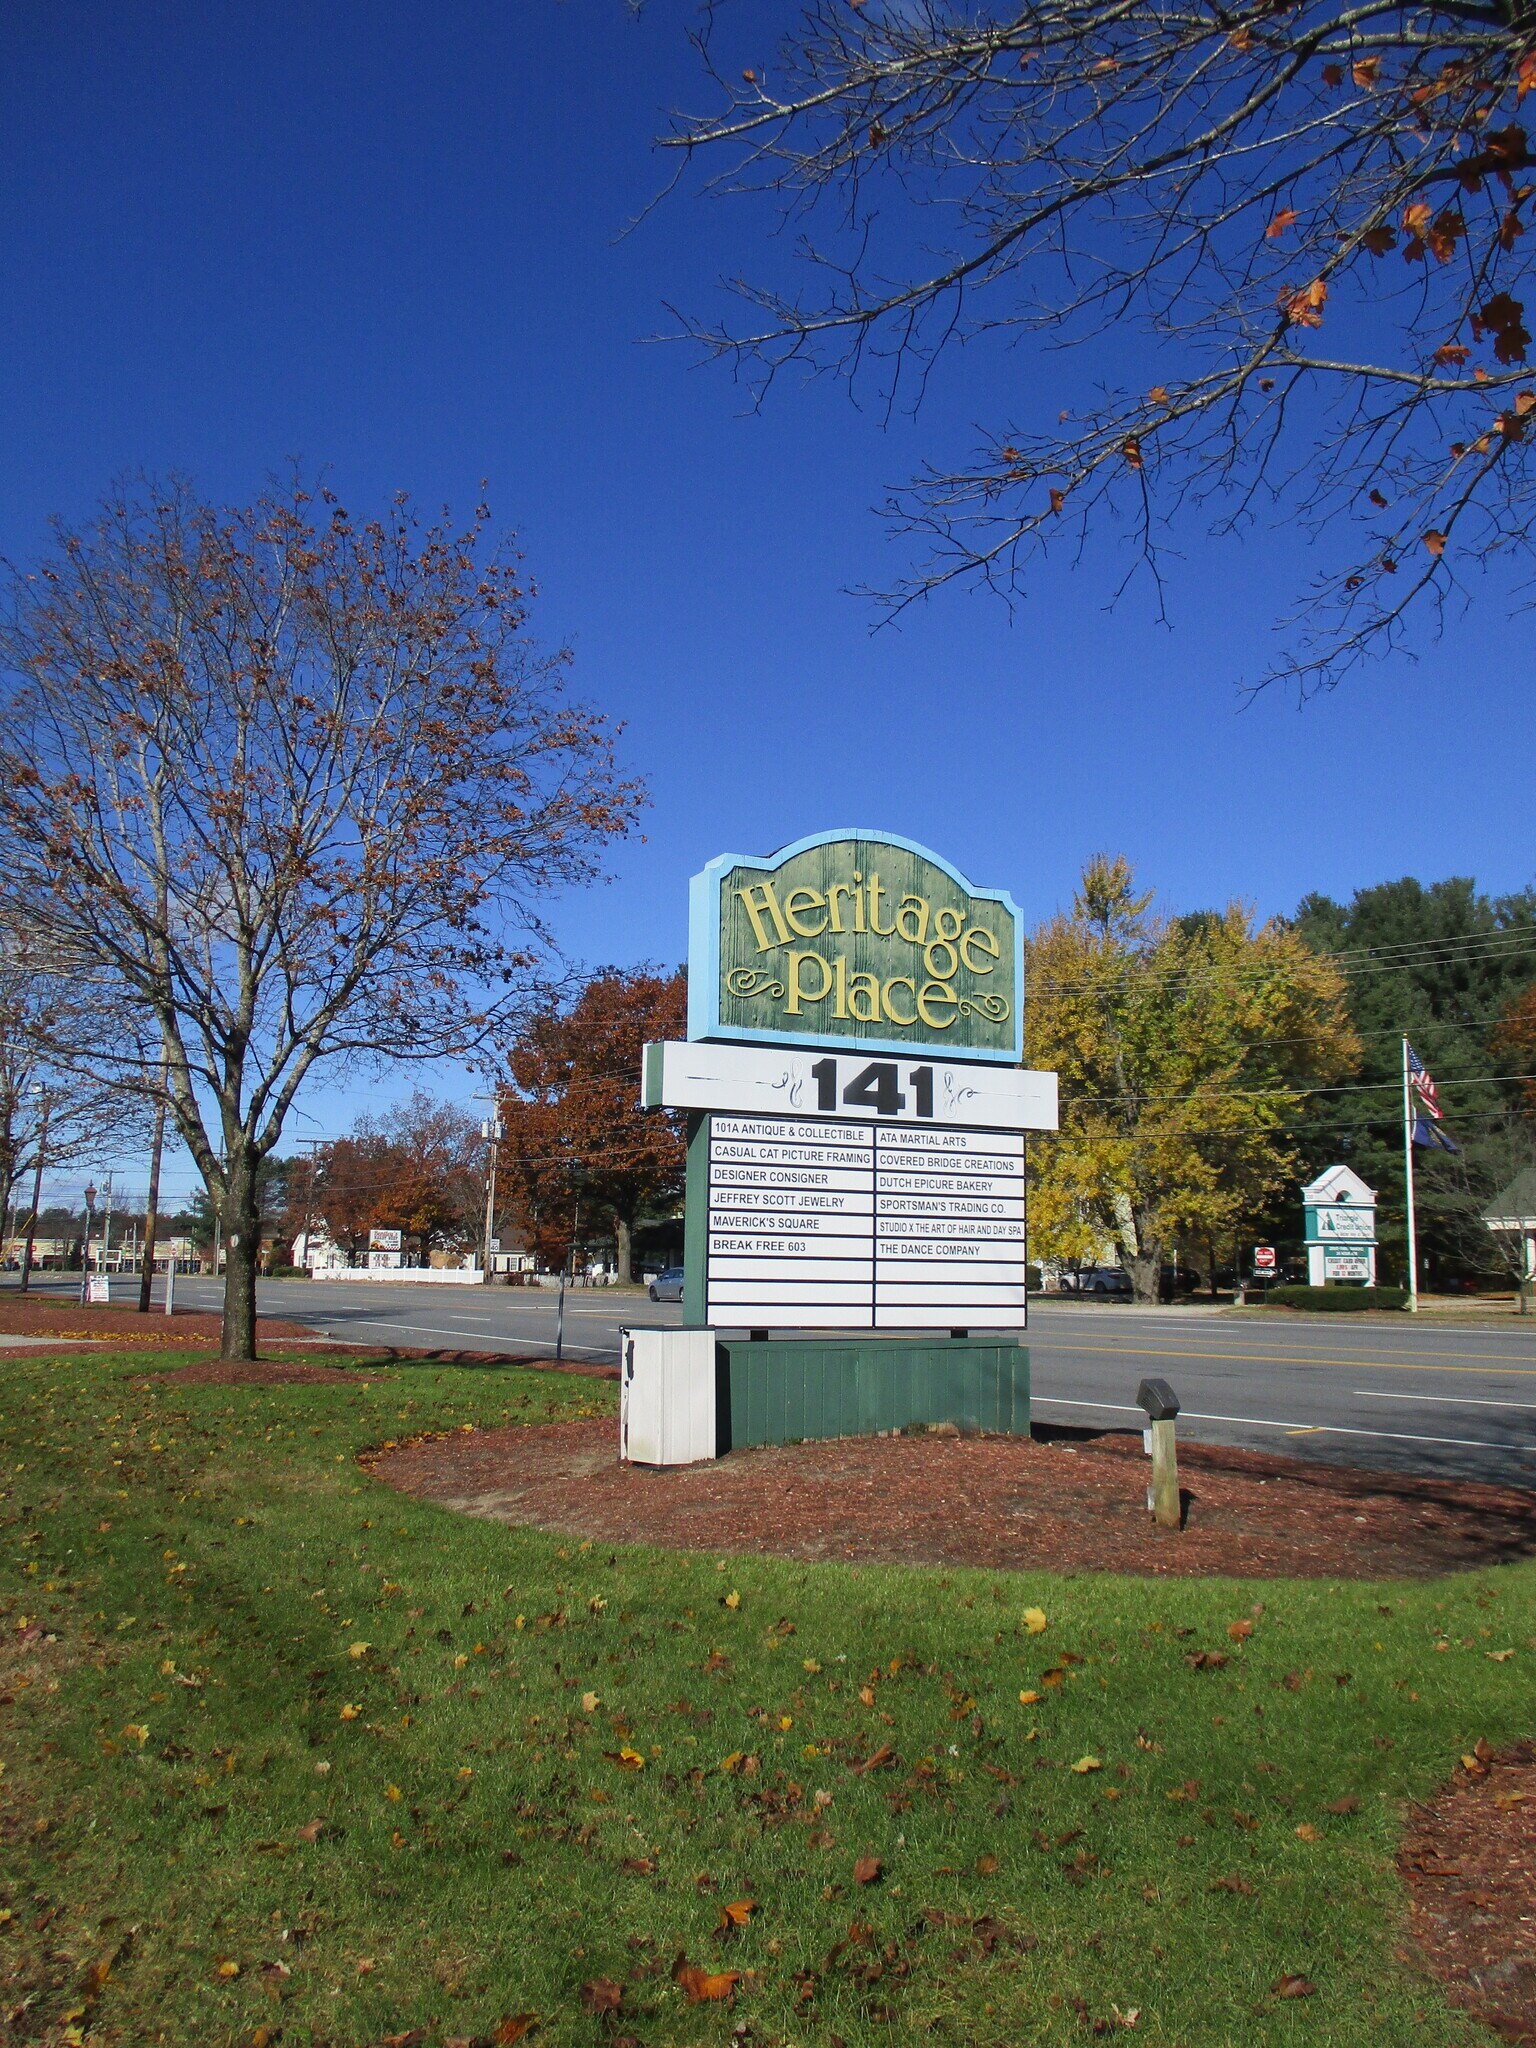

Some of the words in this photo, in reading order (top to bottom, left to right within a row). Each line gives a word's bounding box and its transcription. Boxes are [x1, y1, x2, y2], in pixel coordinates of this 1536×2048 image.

[735, 871, 1000, 980] Heritage
[783, 950, 958, 1029] Place
[811, 1058, 934, 1118] 141
[715, 1122, 739, 1133] 101A
[741, 1124, 786, 1136] ANTIQUE
[788, 1126, 796, 1137] &
[798, 1127, 865, 1141] COLLECTIBLE
[880, 1132, 898, 1143] ATA
[900, 1134, 941, 1146] MARTIAL
[942, 1136, 967, 1147] ARTS
[714, 1145, 757, 1158] CASUAL
[759, 1148, 779, 1159] CAT
[781, 1149, 824, 1161] PICTURE
[826, 1151, 871, 1164] FRAMING
[880, 1154, 925, 1167] COVERED
[927, 1157, 962, 1169] BRIDGE
[964, 1159, 1015, 1171] CREATIONS
[714, 1169, 767, 1181] DESIGNER
[769, 1171, 828, 1184] CONSIGNER
[879, 1177, 912, 1188] DUTCH
[914, 1178, 954, 1190] EPICURE
[956, 1180, 993, 1191] BAKERY
[714, 1192, 760, 1205] JEFFREY
[762, 1194, 796, 1206] SCOTT
[798, 1196, 845, 1208] JEWELRY
[880, 1199, 947, 1212] SPORTSMAN'S
[949, 1202, 989, 1213] TRADING
[991, 1203, 1006, 1214] CO.
[713, 1216, 775, 1228] MAVERICK'S
[778, 1218, 820, 1230] SQUARE
[880, 1221, 908, 1233] STUDIO
[908, 1223, 914, 1232] X
[916, 1223, 930, 1233] THE
[931, 1223, 946, 1234] ART
[947, 1224, 957, 1234] OF
[958, 1224, 976, 1234] HAIR
[976, 1224, 992, 1235] AND
[993, 1225, 1007, 1236] DAY
[1008, 1225, 1022, 1236] SPA
[713, 1239, 753, 1251] BREAK
[756, 1240, 785, 1251] FREE
[788, 1241, 806, 1252] 603
[880, 1243, 899, 1254] THE
[901, 1244, 933, 1255] DANCE
[935, 1245, 980, 1256] COMPANY
